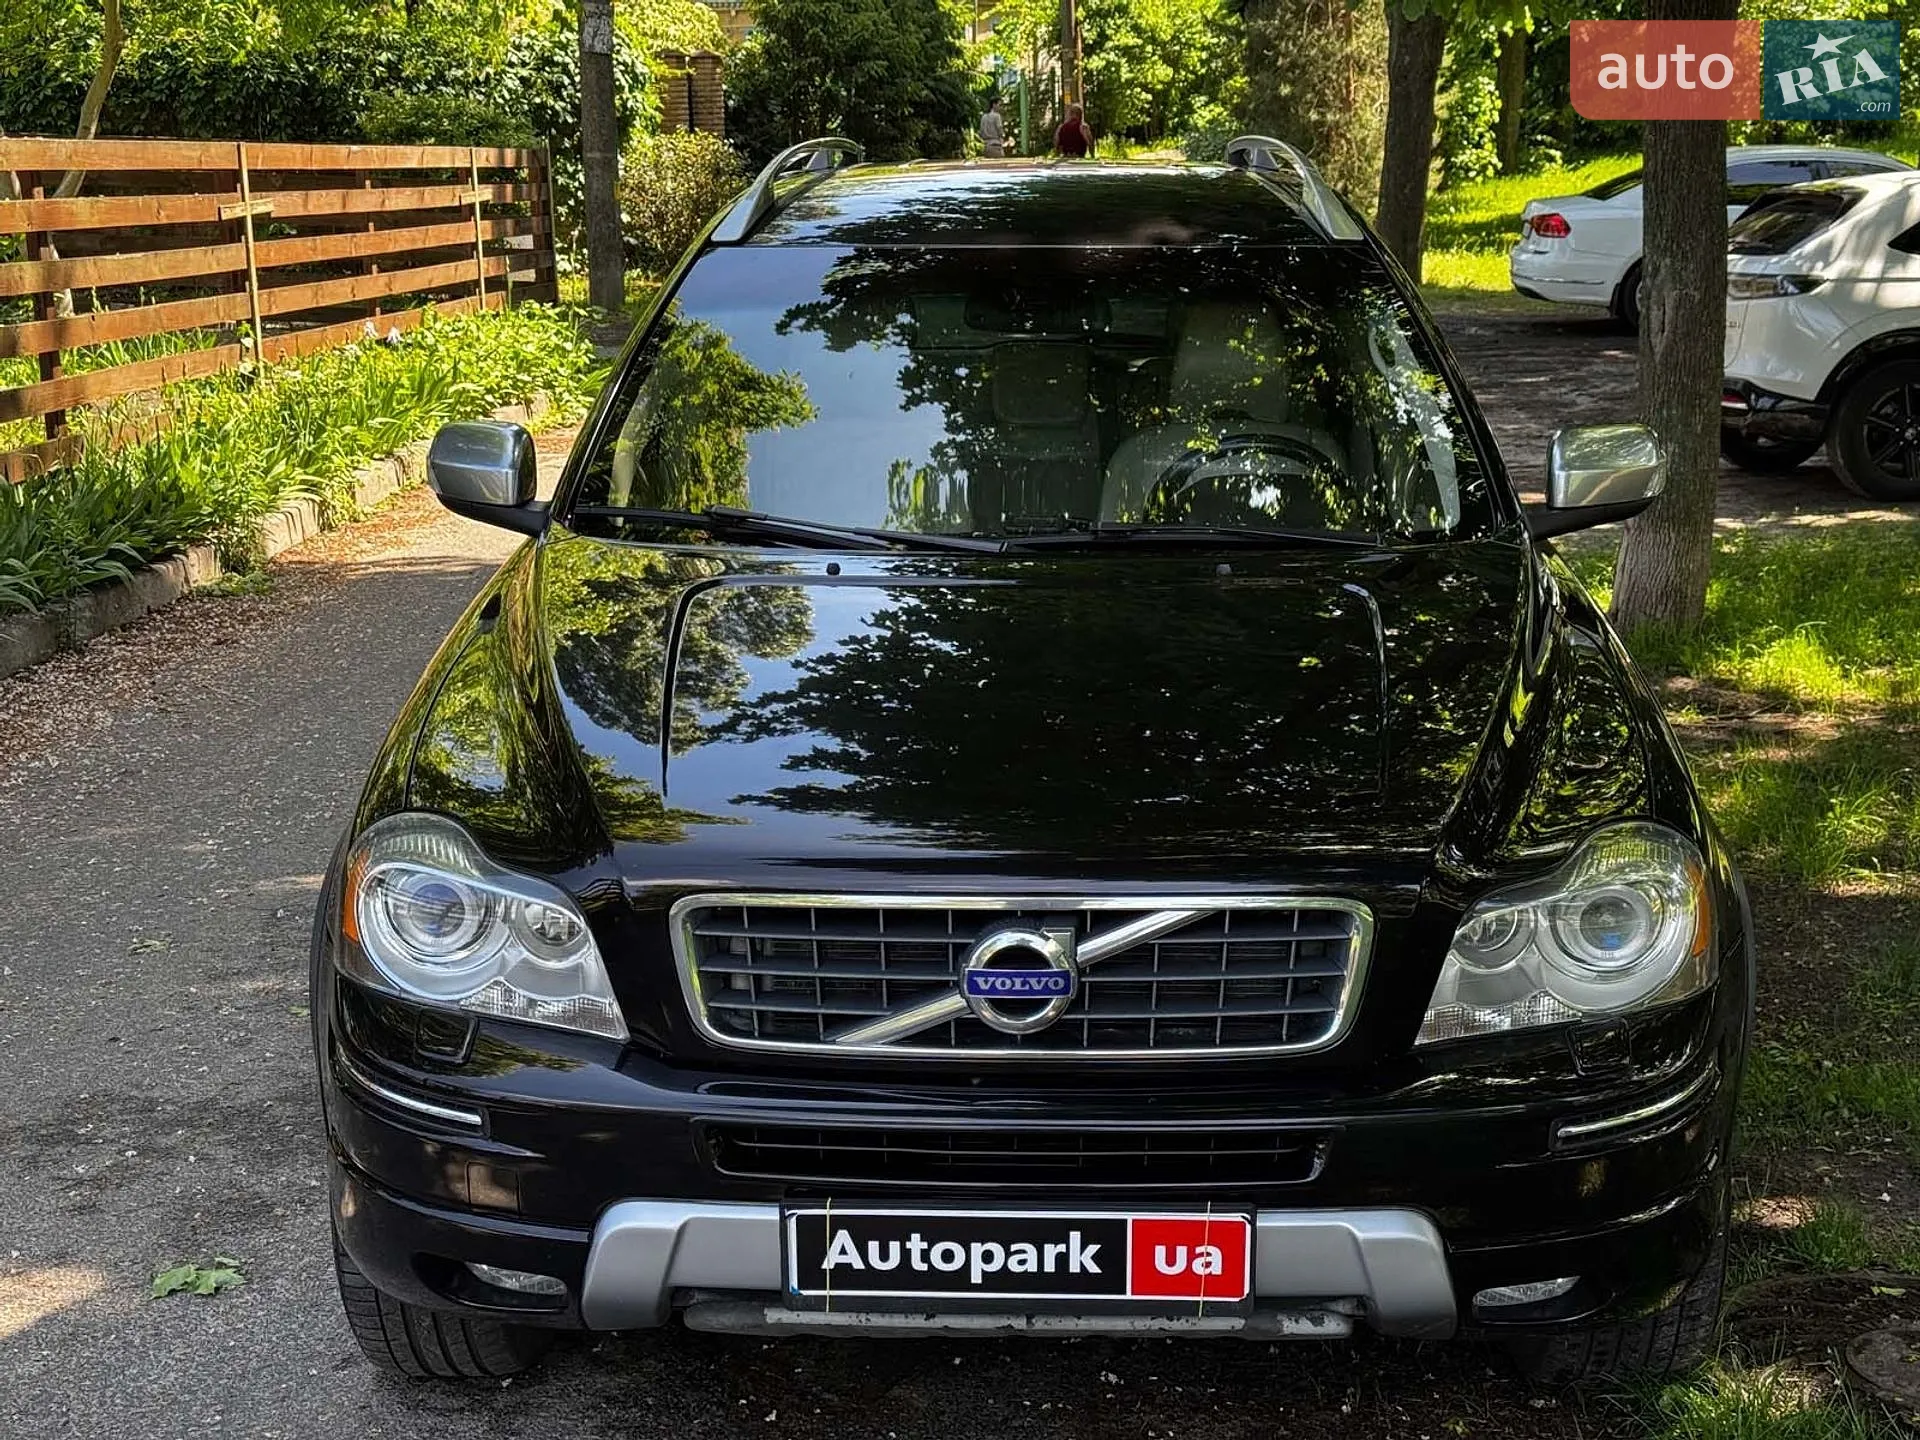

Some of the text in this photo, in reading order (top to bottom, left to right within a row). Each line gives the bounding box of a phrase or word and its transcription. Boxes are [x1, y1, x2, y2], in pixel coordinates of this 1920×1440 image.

[973, 976, 1065, 991] VOLVO
[820, 1229, 1223, 1284] Autopark ua
